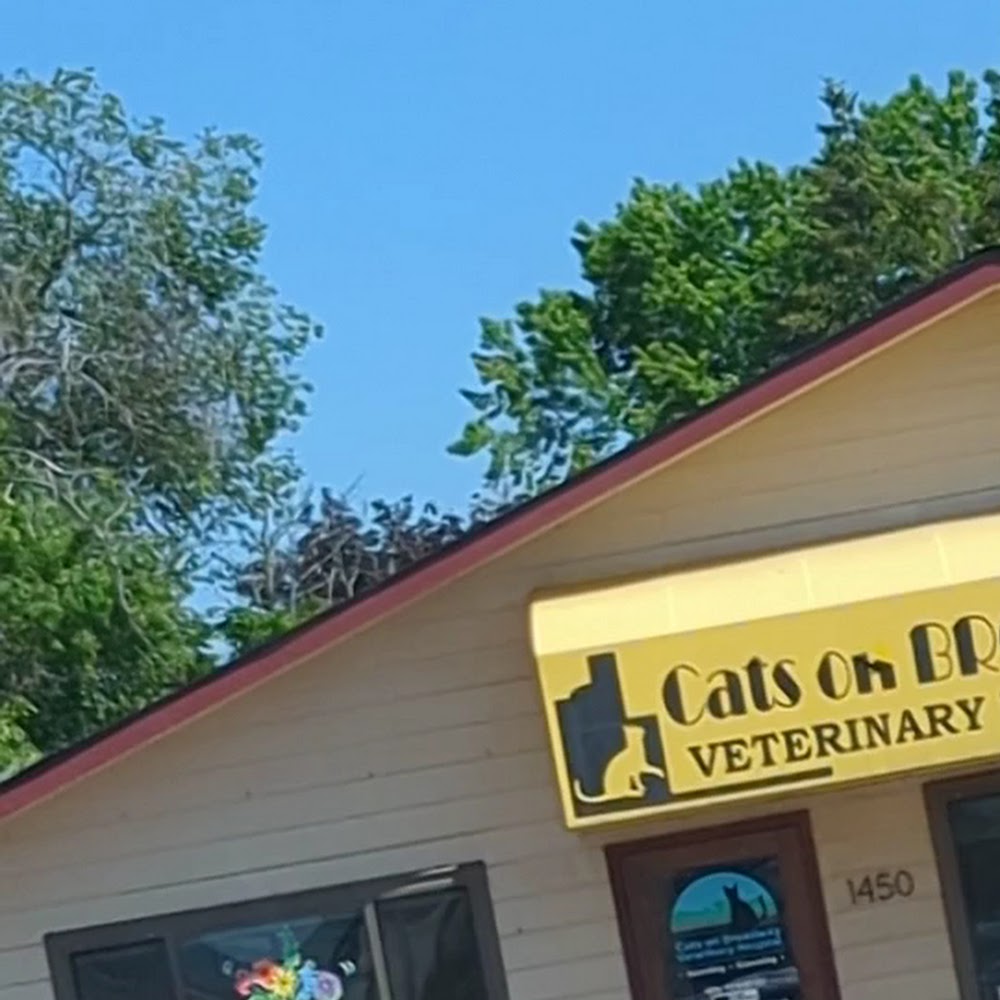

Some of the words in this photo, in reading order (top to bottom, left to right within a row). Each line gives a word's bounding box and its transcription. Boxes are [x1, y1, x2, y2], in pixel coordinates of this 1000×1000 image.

[662, 663, 803, 726] Cats
[816, 650, 898, 702] On
[687, 696, 986, 778] VETERINARY
[846, 869, 915, 905] 1450
